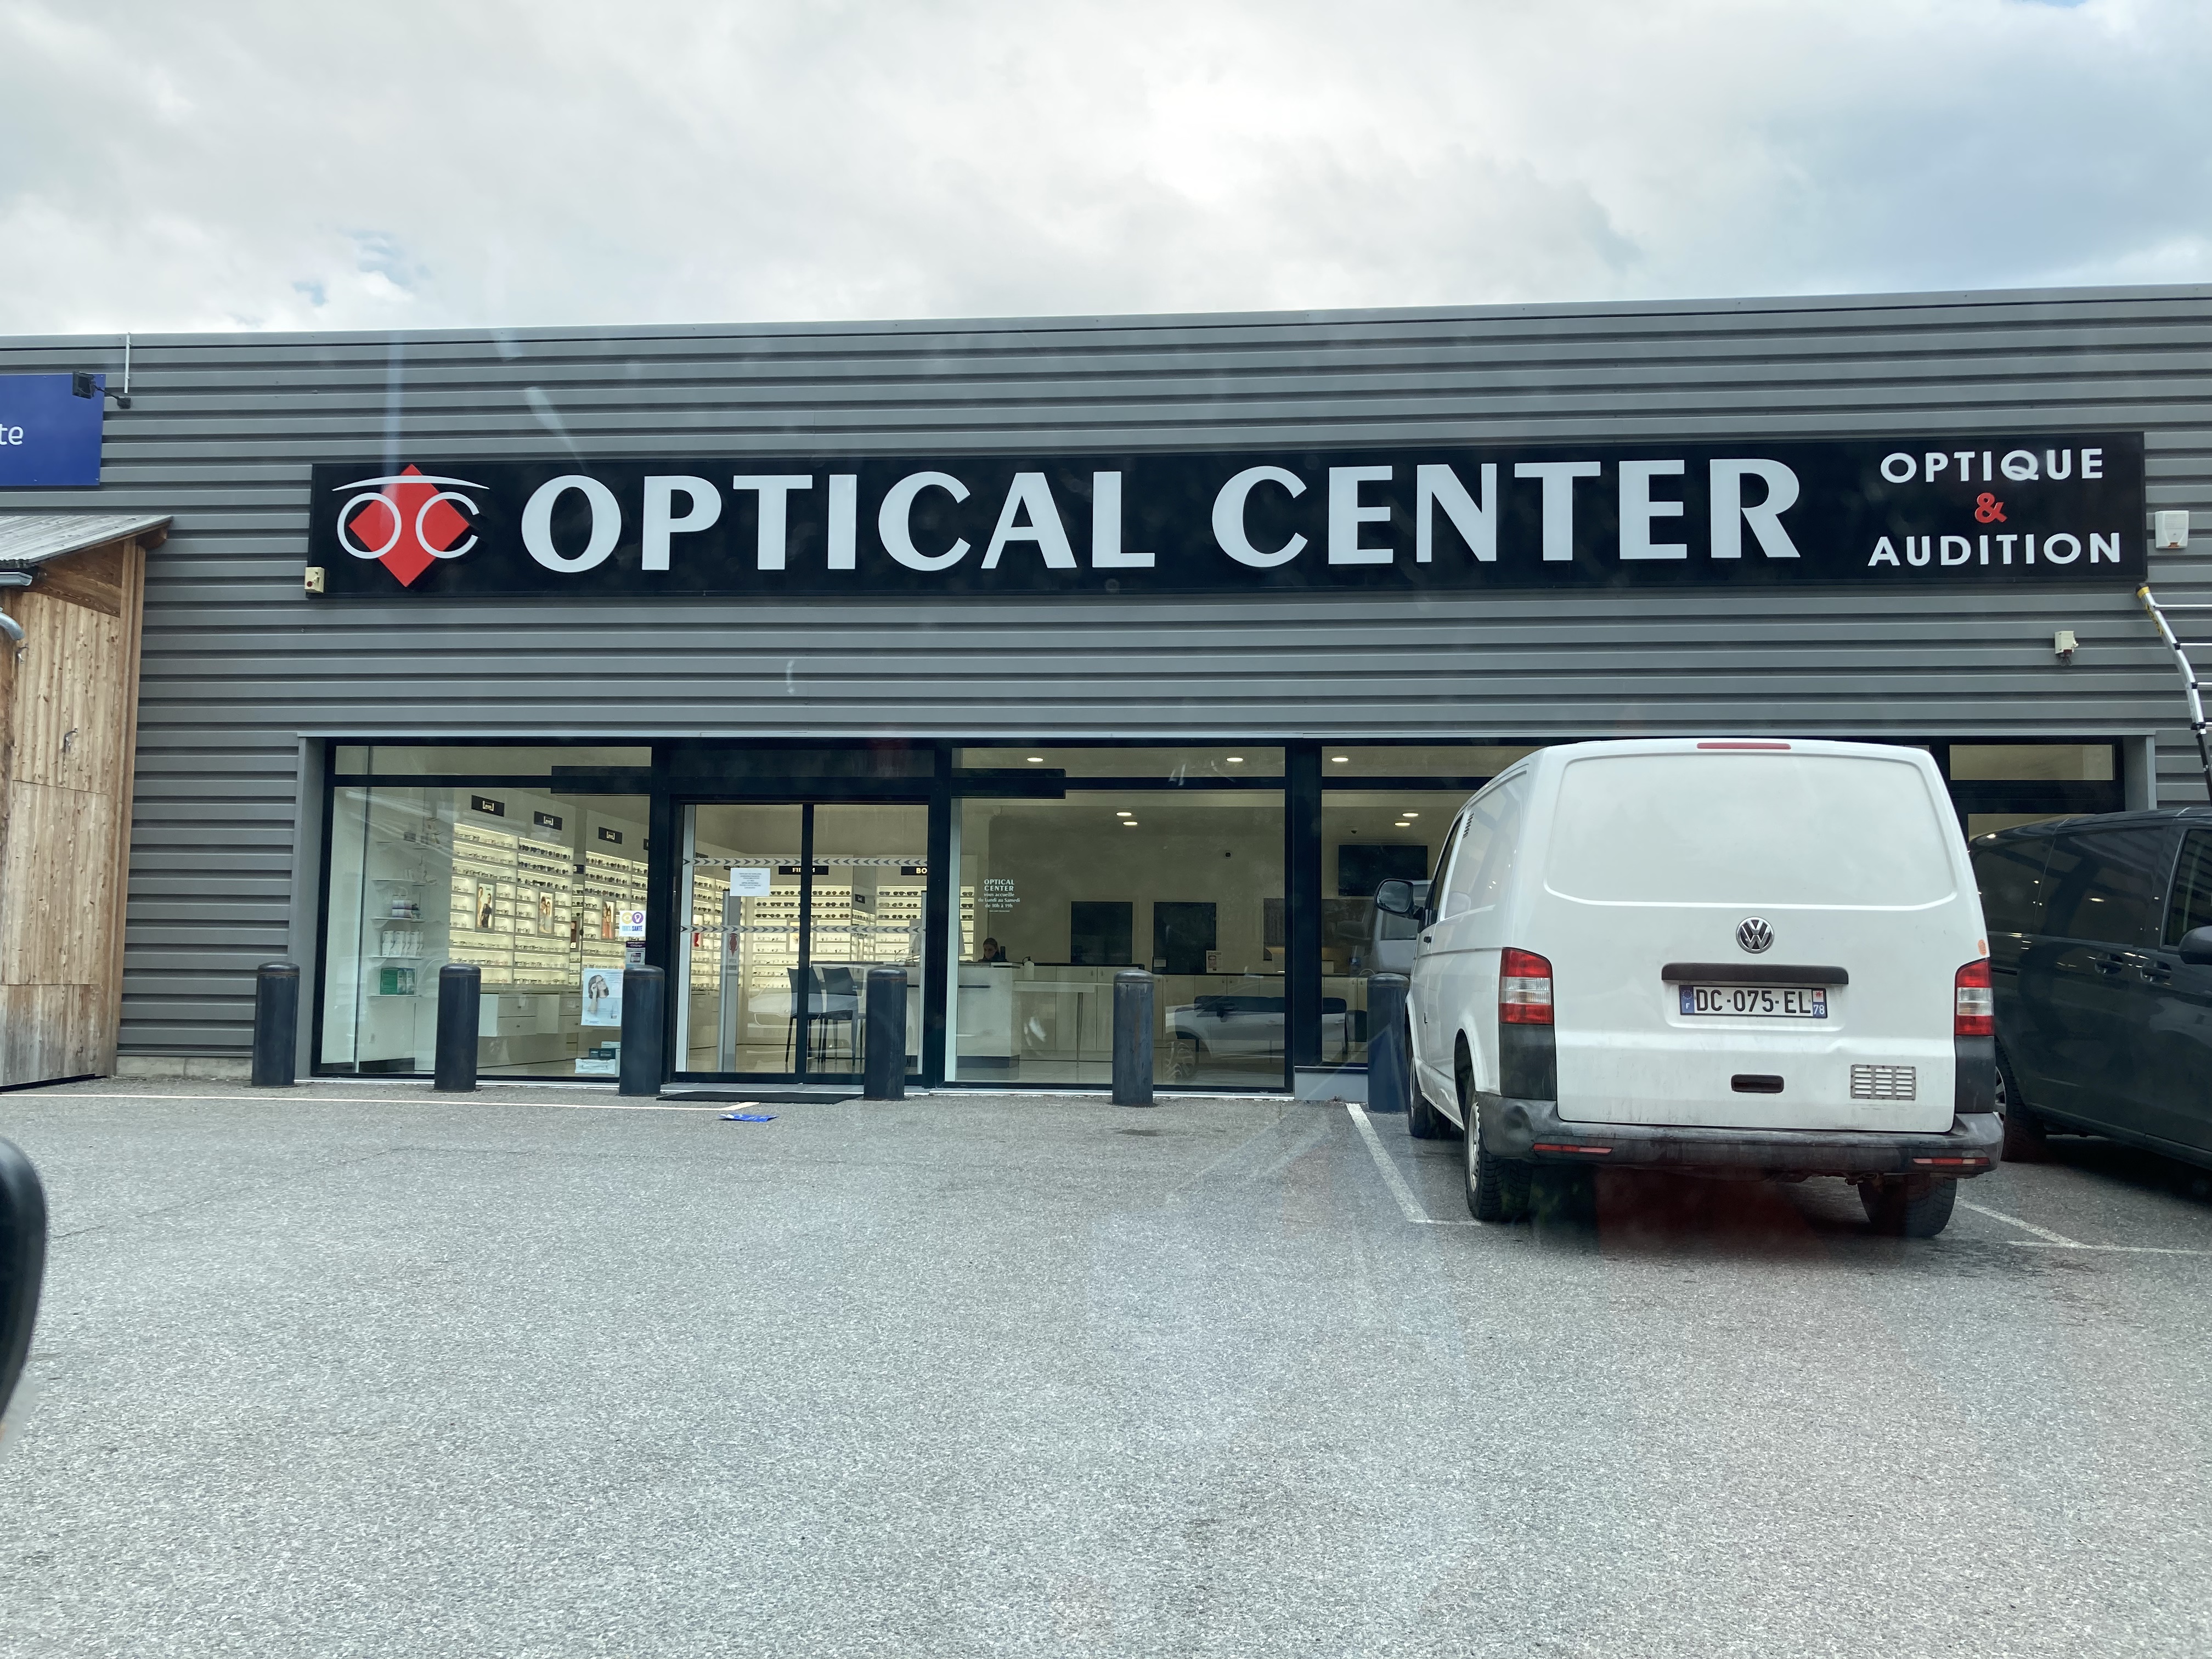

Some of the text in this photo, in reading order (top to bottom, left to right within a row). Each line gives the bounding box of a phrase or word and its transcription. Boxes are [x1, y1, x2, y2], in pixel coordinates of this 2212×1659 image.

[1880, 448, 2103, 483] OPTIQUE
[521, 459, 1801, 573] OPTICAL CENTER
[1976, 493, 2006, 523] &
[1867, 532, 2121, 566] AUDITION
[1813, 1004, 1825, 1015] 78
